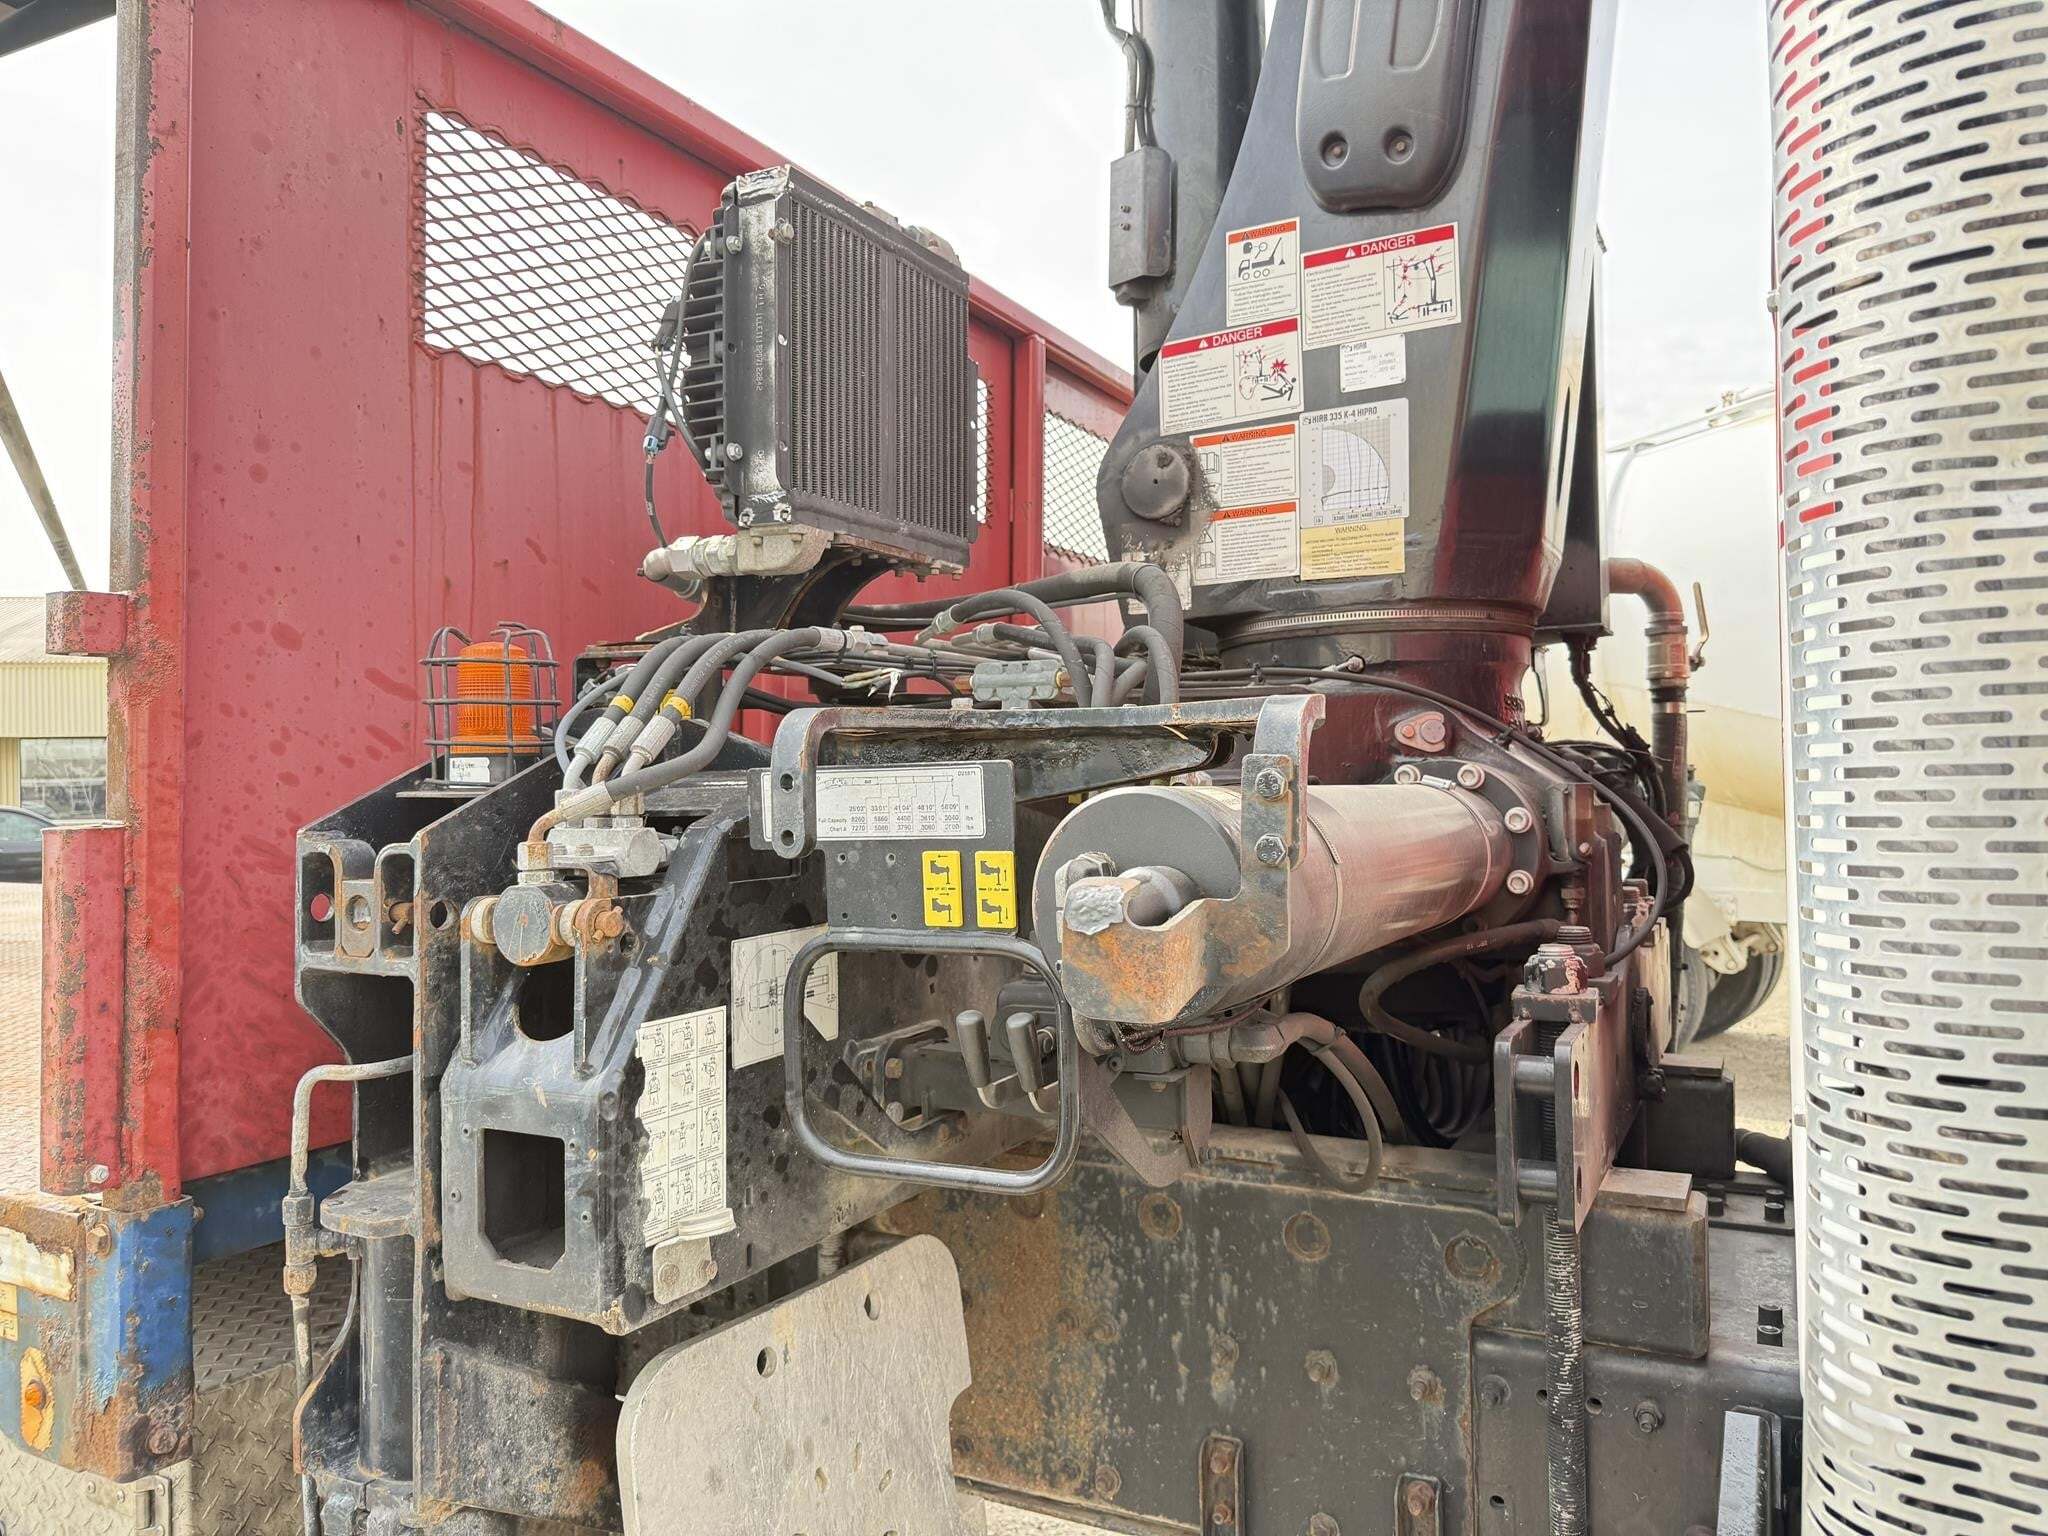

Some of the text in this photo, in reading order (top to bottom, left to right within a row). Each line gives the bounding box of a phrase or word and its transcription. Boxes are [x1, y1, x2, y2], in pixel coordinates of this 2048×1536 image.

[1251, 225, 1286, 239] WARNING
[1361, 234, 1416, 256] DANGER
[1212, 327, 1263, 346] DANGER
[1330, 412, 1343, 421] 335
[1357, 407, 1378, 417] HIPRO
[1231, 429, 1267, 441] WARNING
[1232, 506, 1268, 518] WARNING
